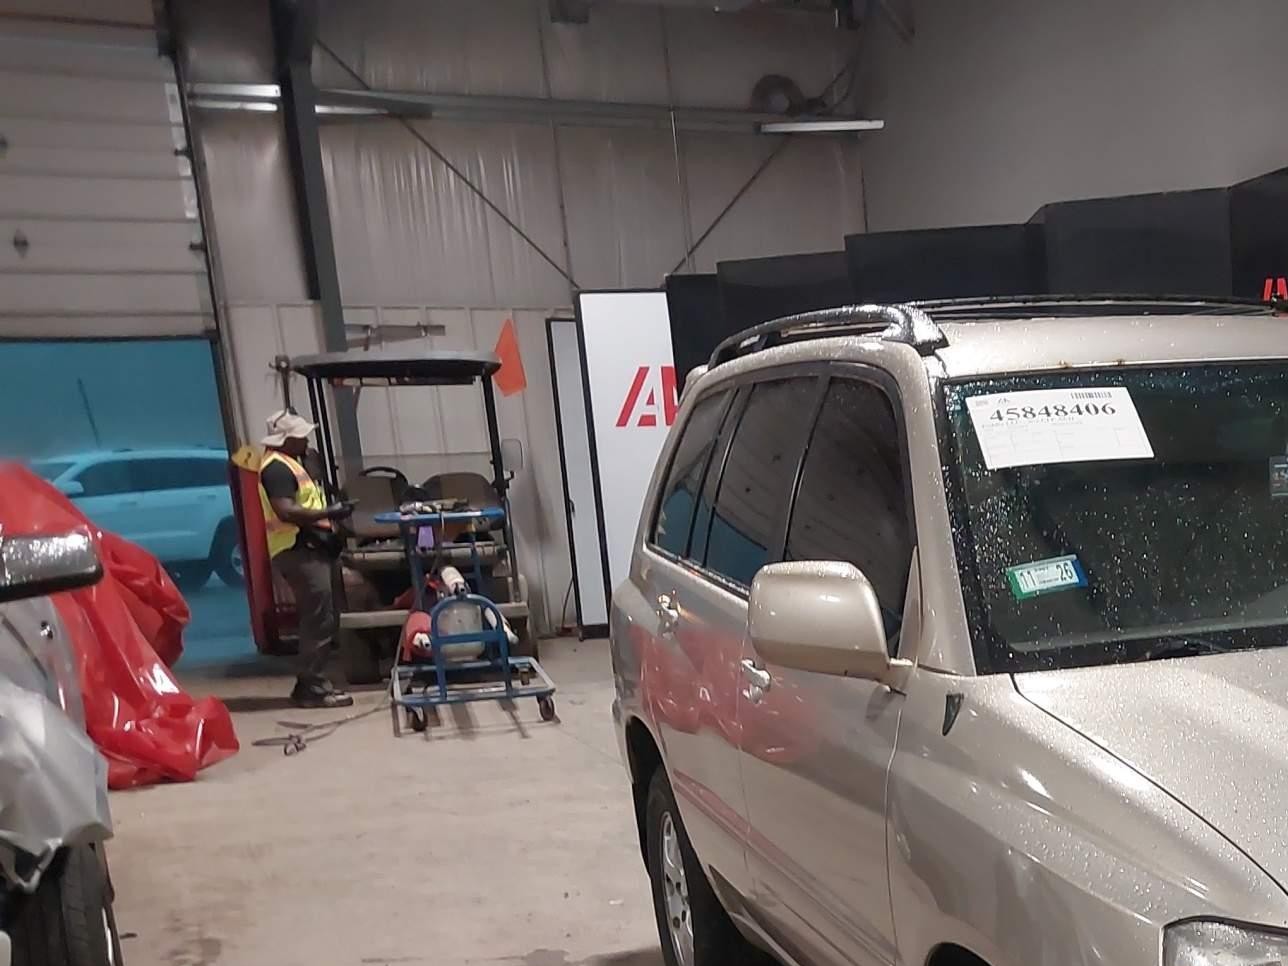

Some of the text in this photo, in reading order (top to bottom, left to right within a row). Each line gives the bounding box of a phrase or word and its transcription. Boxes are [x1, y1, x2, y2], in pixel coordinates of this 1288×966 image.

[989, 402, 1116, 422] 45848406
[1020, 562, 1073, 588] 11 26
